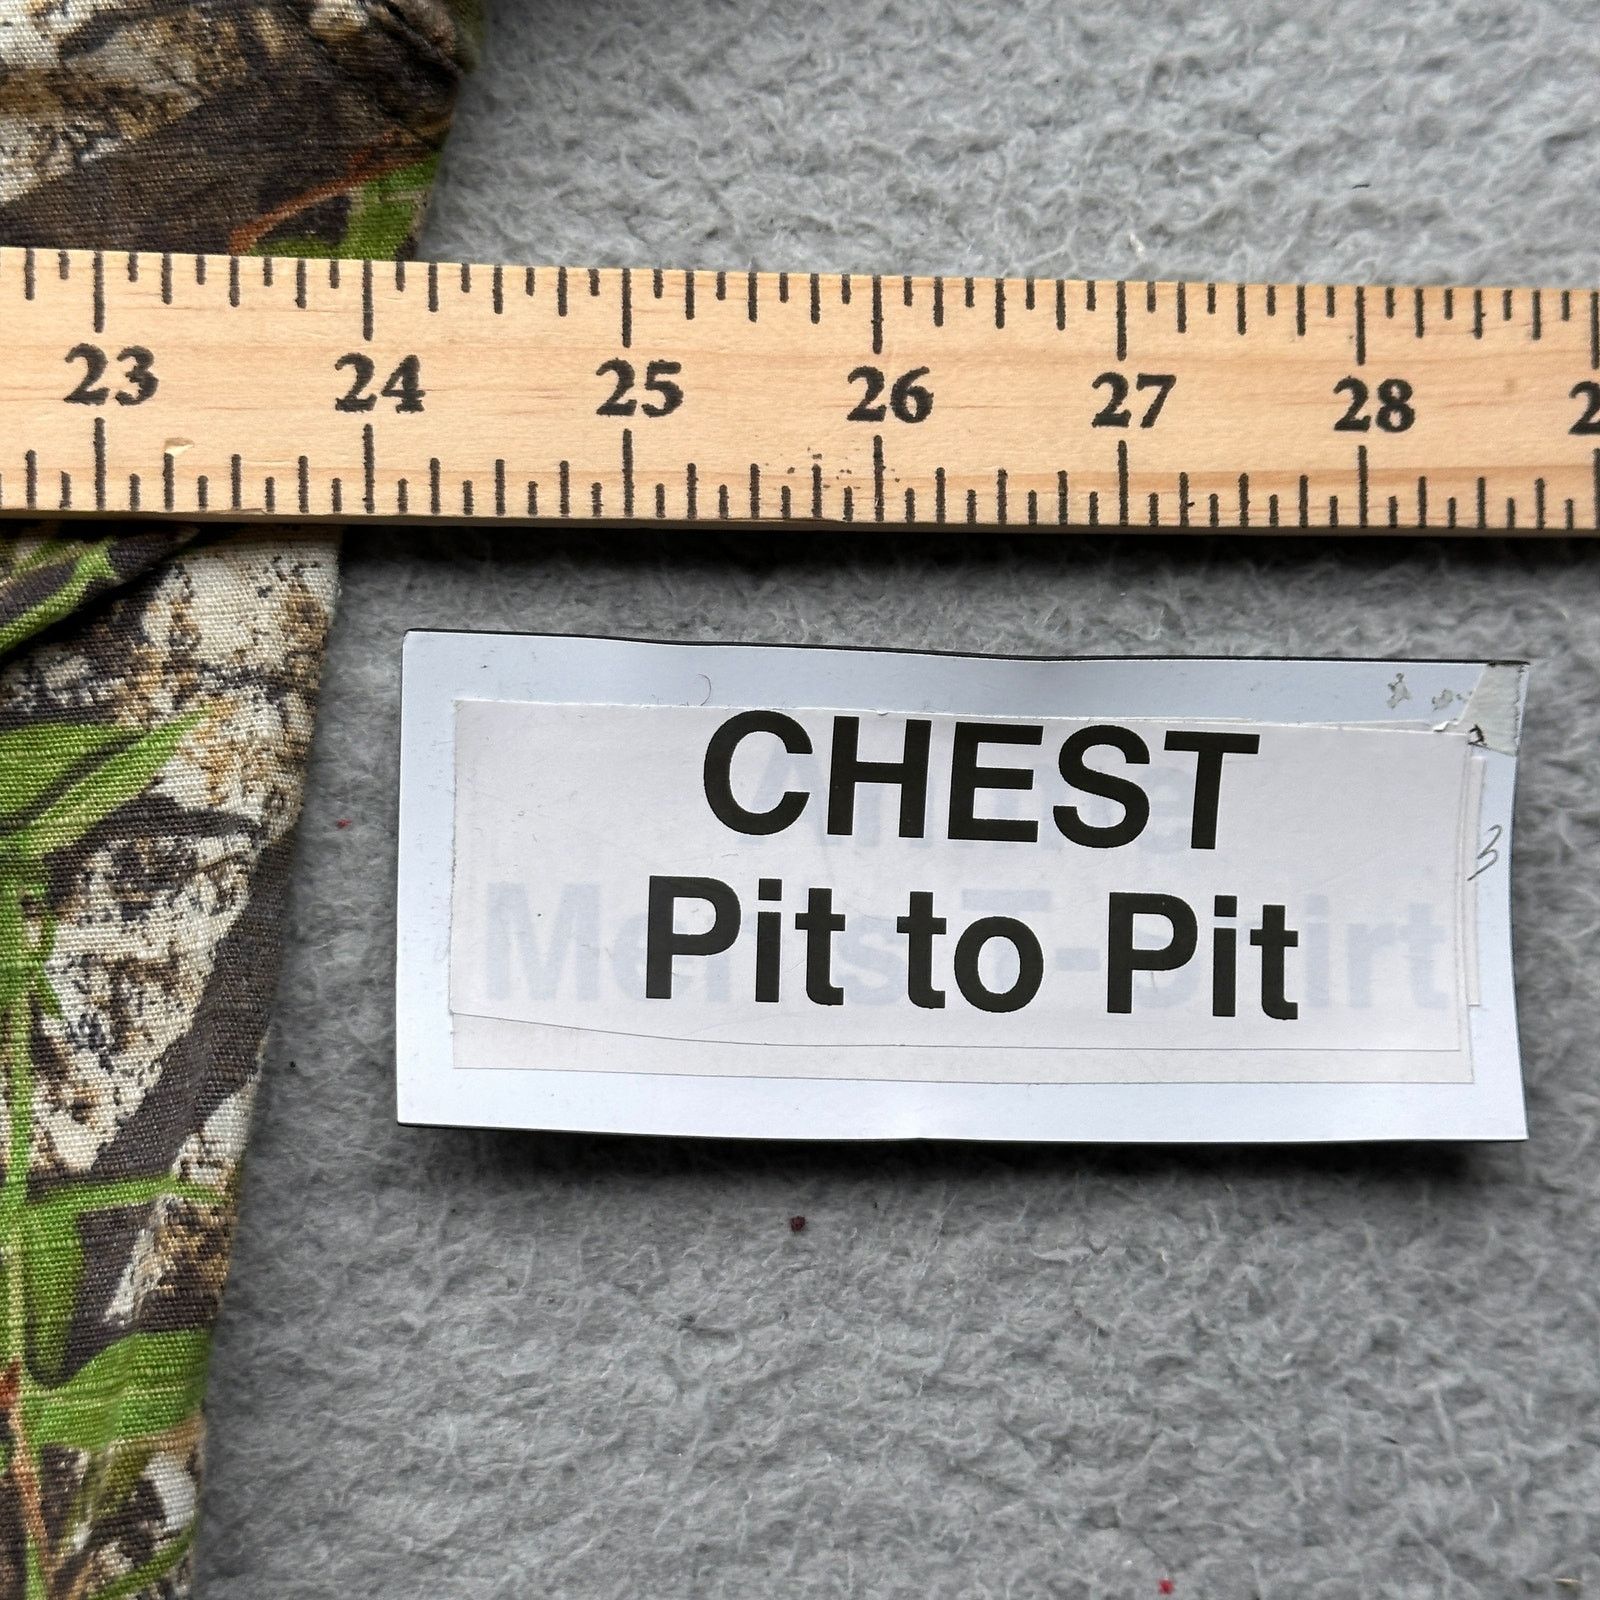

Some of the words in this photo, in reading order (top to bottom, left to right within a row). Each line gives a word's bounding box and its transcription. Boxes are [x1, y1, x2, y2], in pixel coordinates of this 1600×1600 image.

[64, 344, 158, 406] 23
[335, 354, 425, 413] 24
[596, 358, 683, 417] 25
[846, 366, 934, 424] 26
[1091, 373, 1177, 429] 27
[1333, 376, 1415, 433] 28
[1568, 380, 1600, 435] 2
[703, 709, 1260, 850] CHEST
[645, 875, 846, 1007] Pit
[896, 892, 1044, 1014] to
[1106, 892, 1299, 1020] Pit
